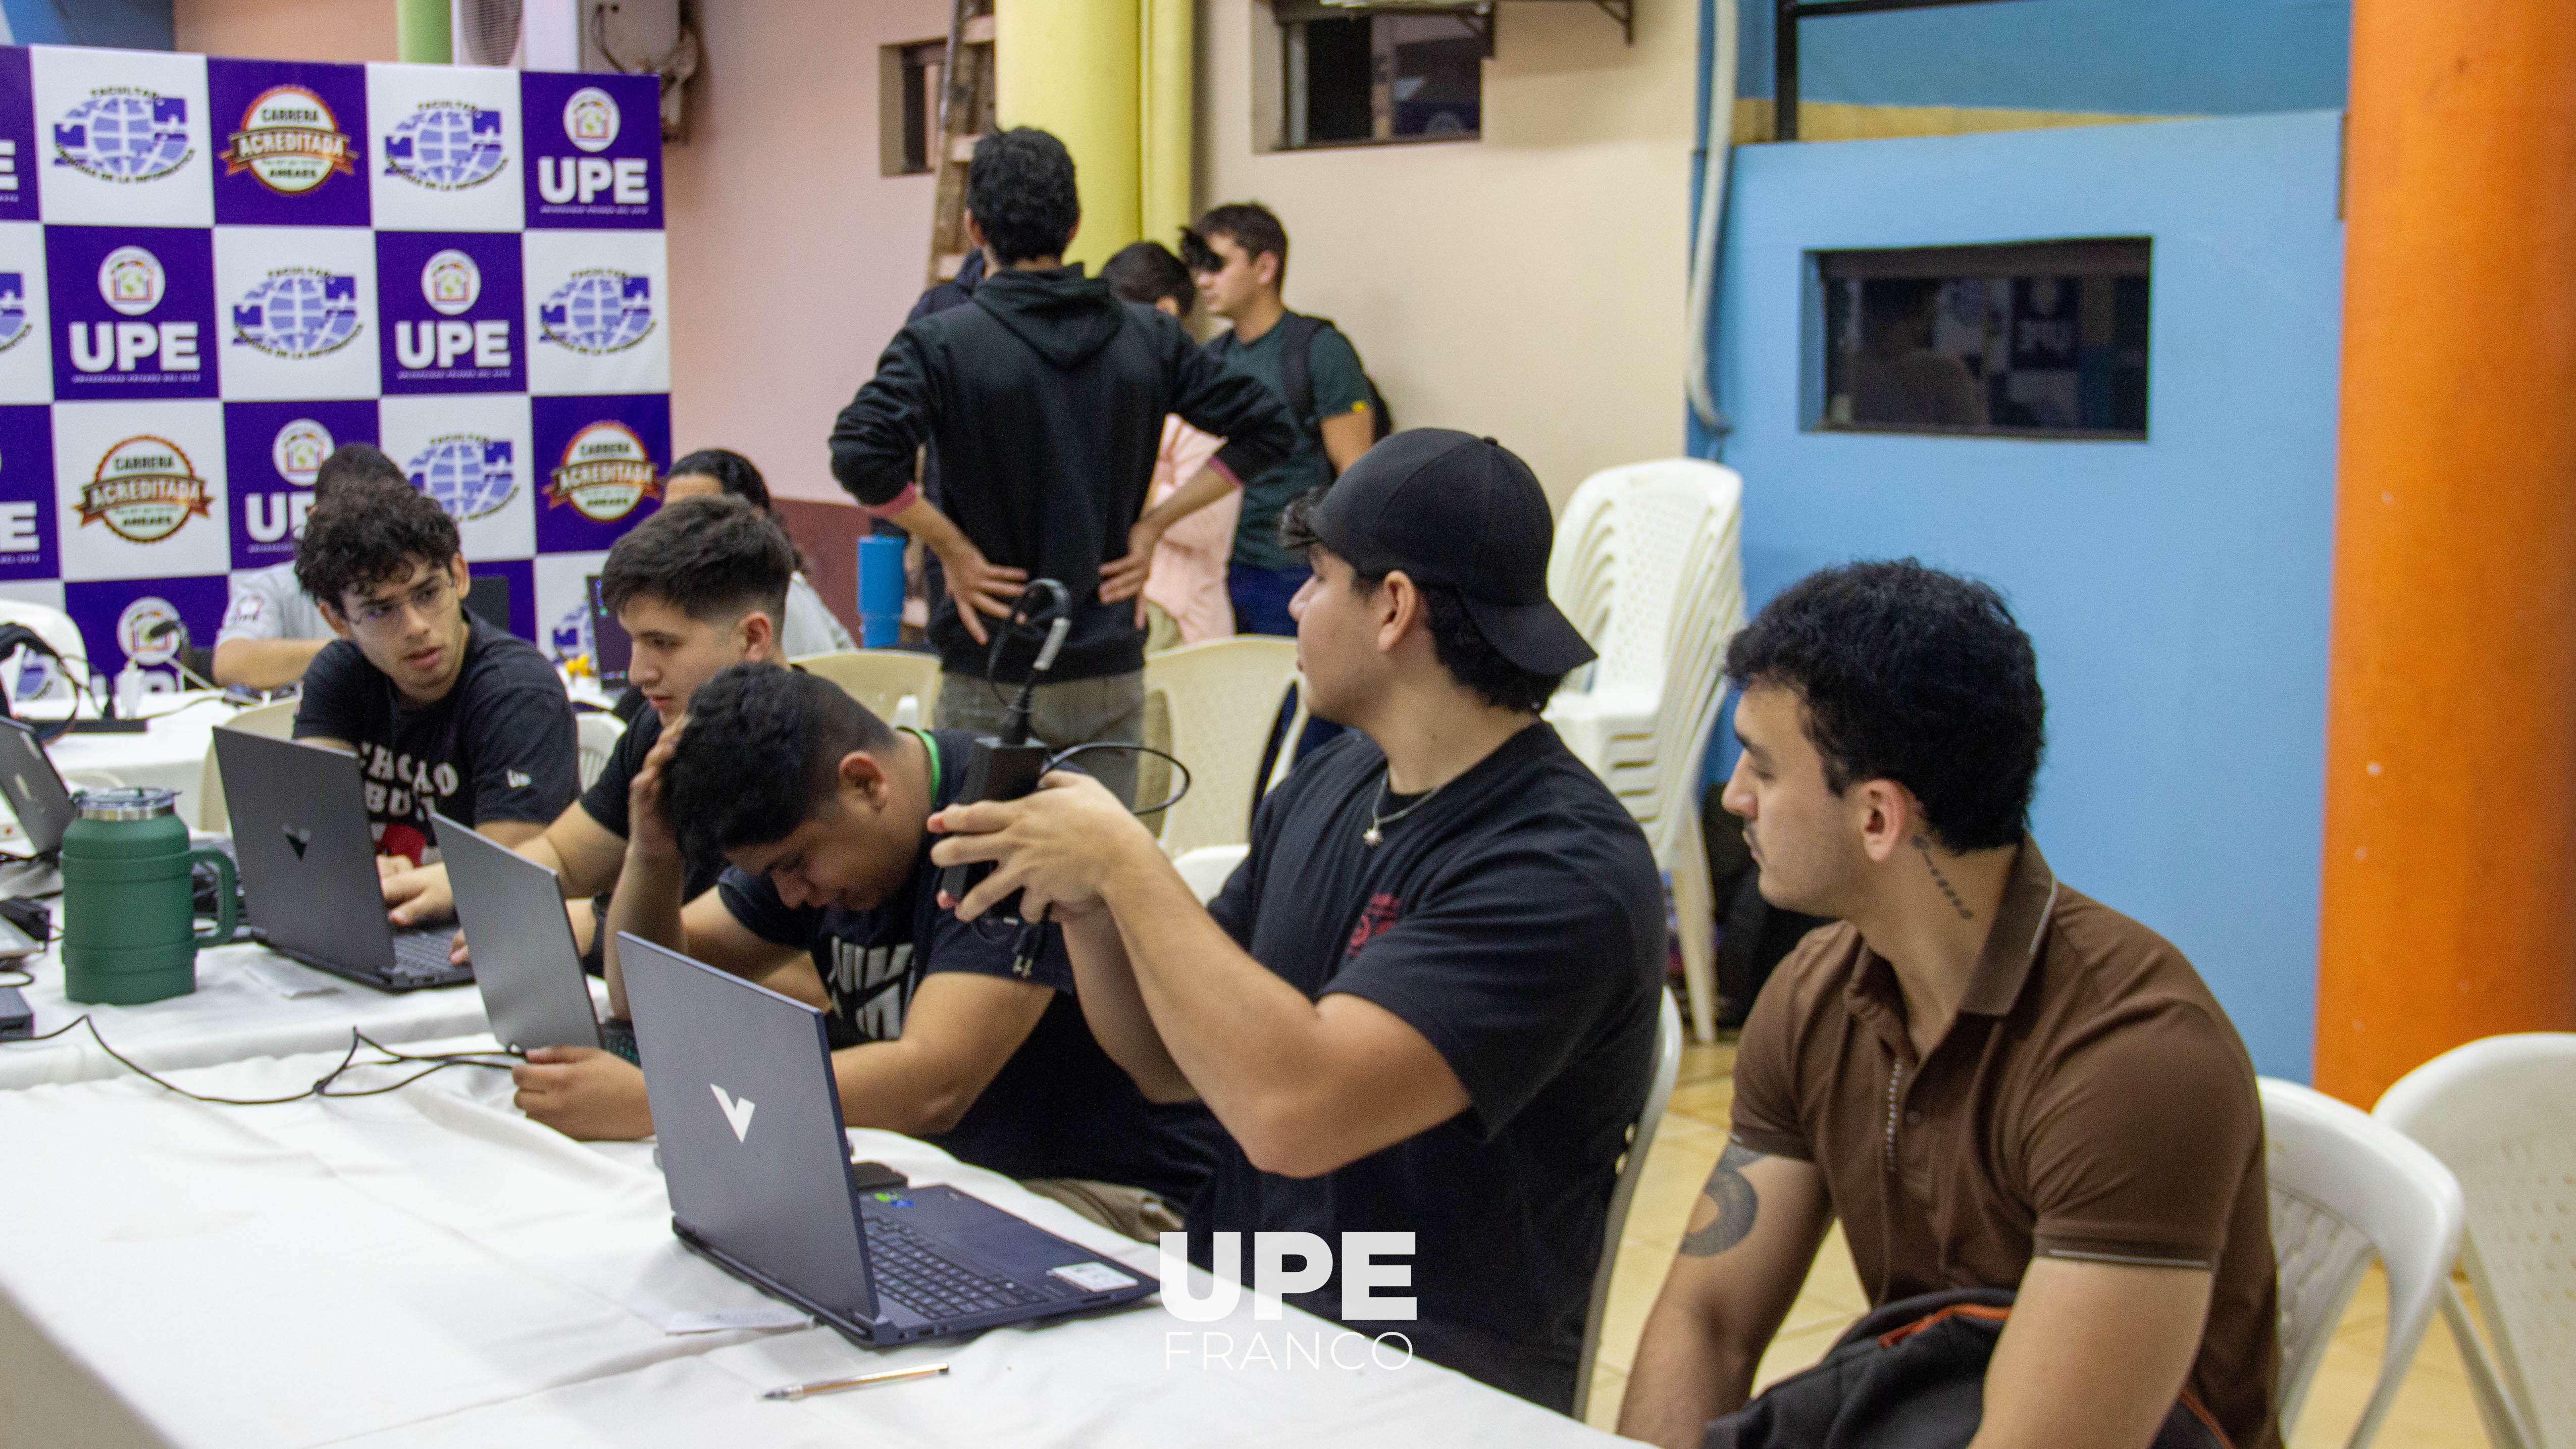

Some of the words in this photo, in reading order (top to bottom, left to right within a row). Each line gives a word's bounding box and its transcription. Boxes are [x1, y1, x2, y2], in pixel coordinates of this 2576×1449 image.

[262, 108, 319, 122] CARRERA
[238, 132, 344, 157] ACREDITADA
[537, 156, 650, 204] UPE
[68, 321, 200, 373] UPE
[395, 320, 511, 369] UPE
[114, 455, 174, 471] CARRERA
[559, 464, 653, 489] ACREDITADA
[91, 480, 200, 506] ACREDITADA
[244, 491, 316, 542] UP
